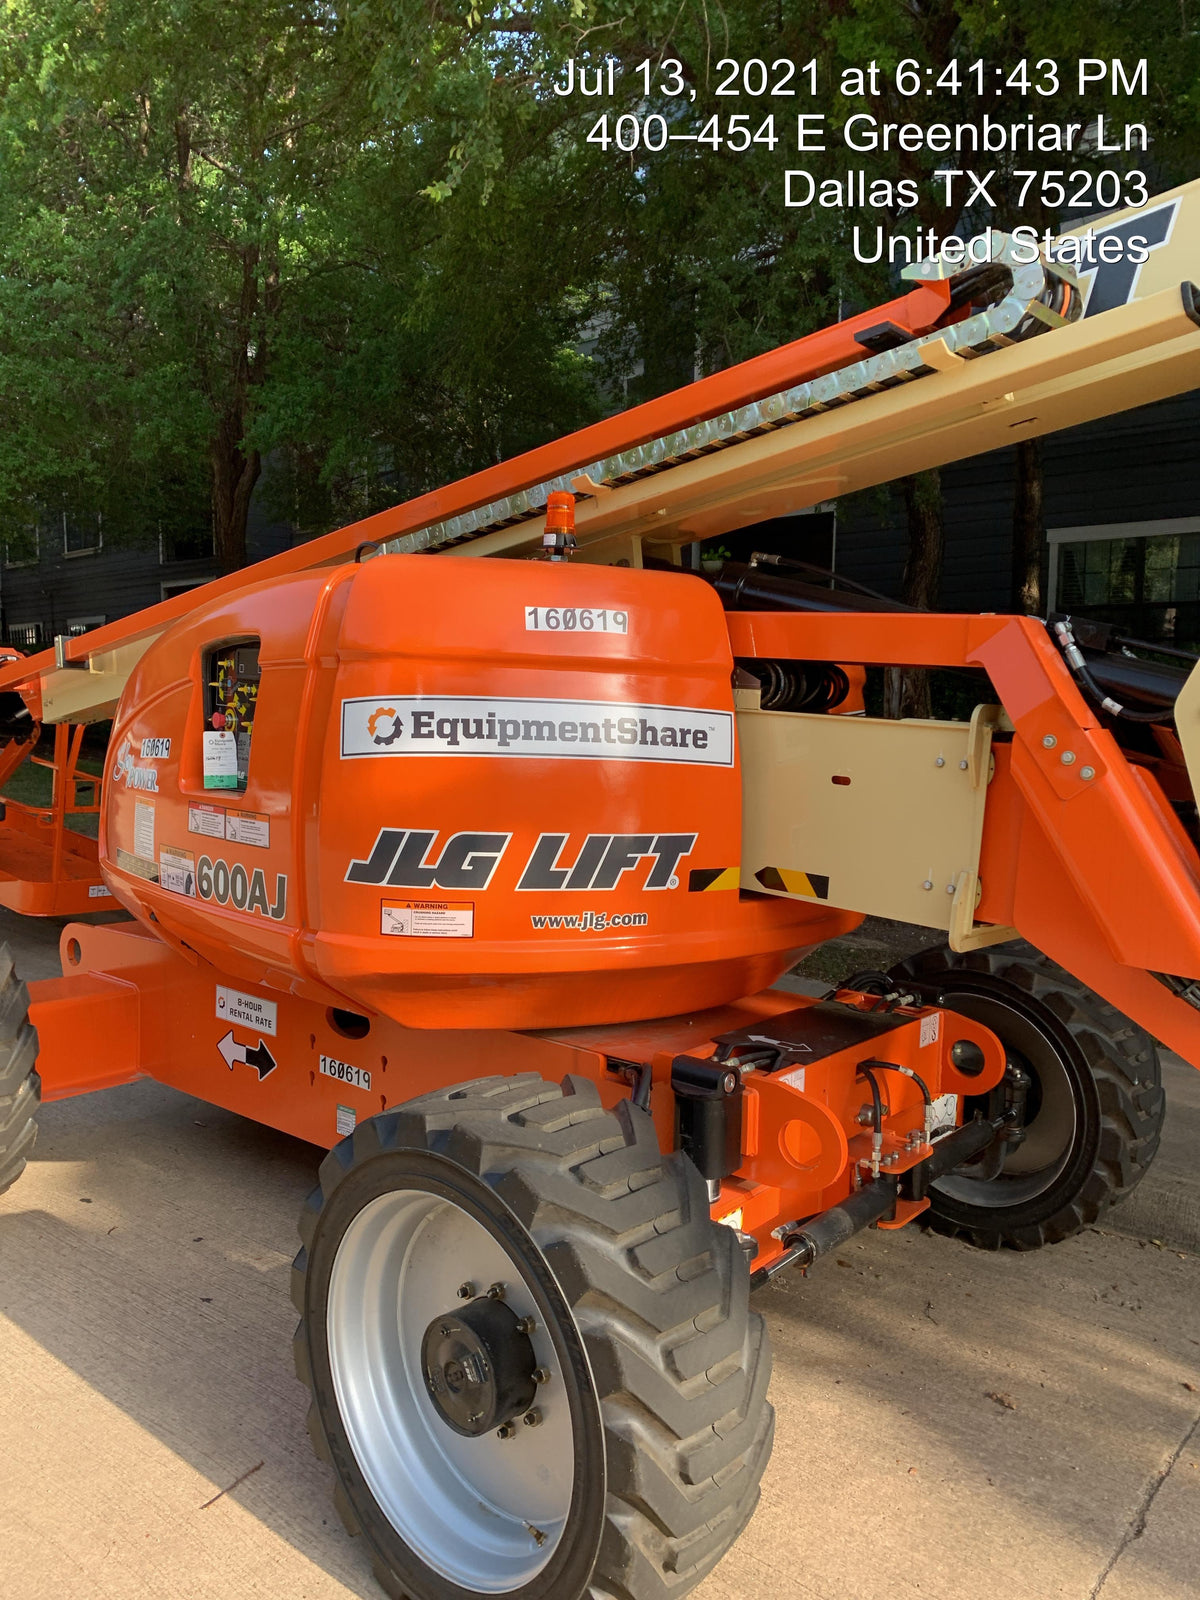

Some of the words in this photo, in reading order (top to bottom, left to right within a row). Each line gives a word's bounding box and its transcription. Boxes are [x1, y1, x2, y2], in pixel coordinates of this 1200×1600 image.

[526, 607, 628, 633] 160619
[410, 711, 709, 750] EquipmentShare
[344, 827, 513, 890] JLG
[515, 833, 699, 891] LIFT
[197, 855, 288, 921] 600AJ
[413, 902, 448, 910] WARNING
[530, 911, 648, 932] www.jlg.com
[237, 997, 263, 1012] 8-HOUR
[229, 1007, 254, 1023] RENTAL
[255, 1015, 273, 1029] RATE
[320, 1056, 371, 1090] 160619
